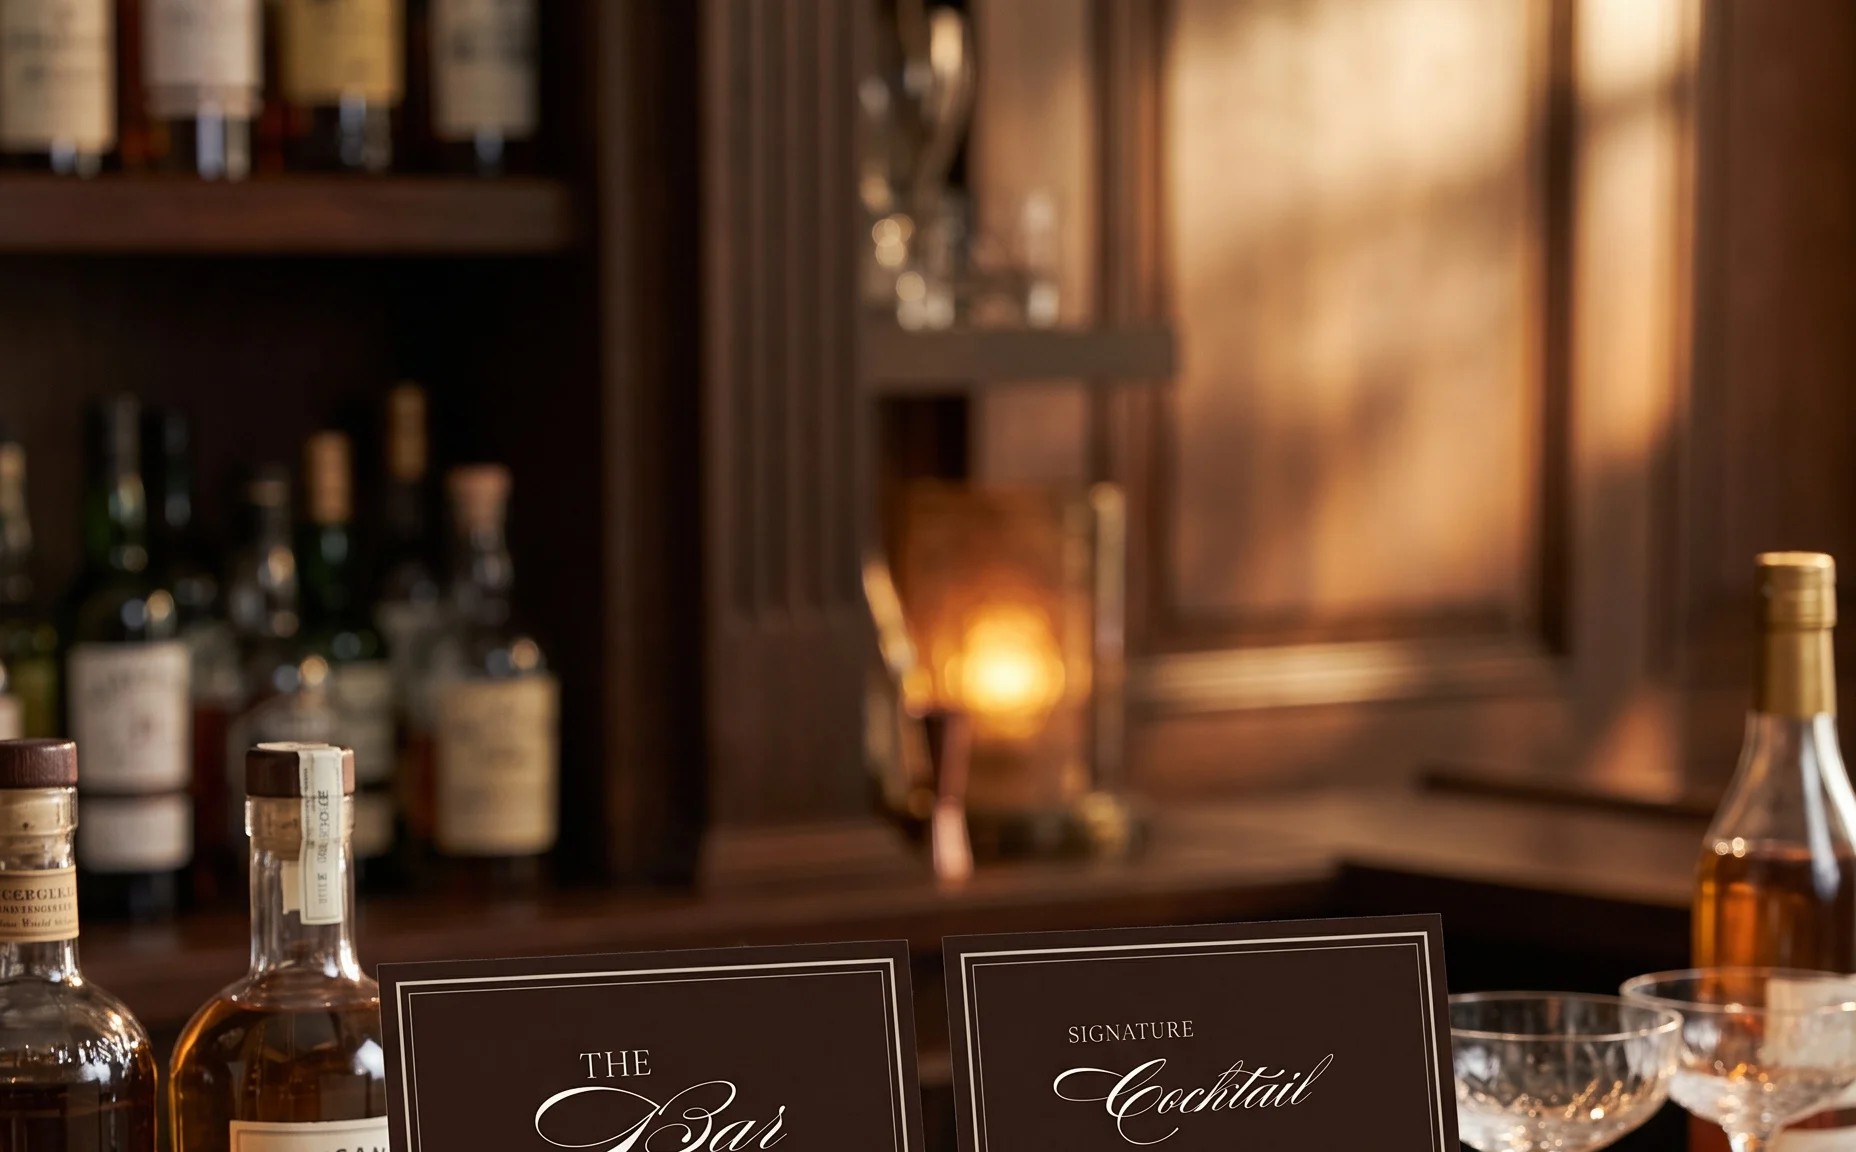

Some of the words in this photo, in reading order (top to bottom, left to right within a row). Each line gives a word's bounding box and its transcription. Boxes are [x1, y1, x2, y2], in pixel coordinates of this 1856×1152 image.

[1068, 1020, 1194, 1043] SIGNATURE
[579, 1049, 651, 1079] THE
[1053, 1053, 1334, 1145] Cocktail
